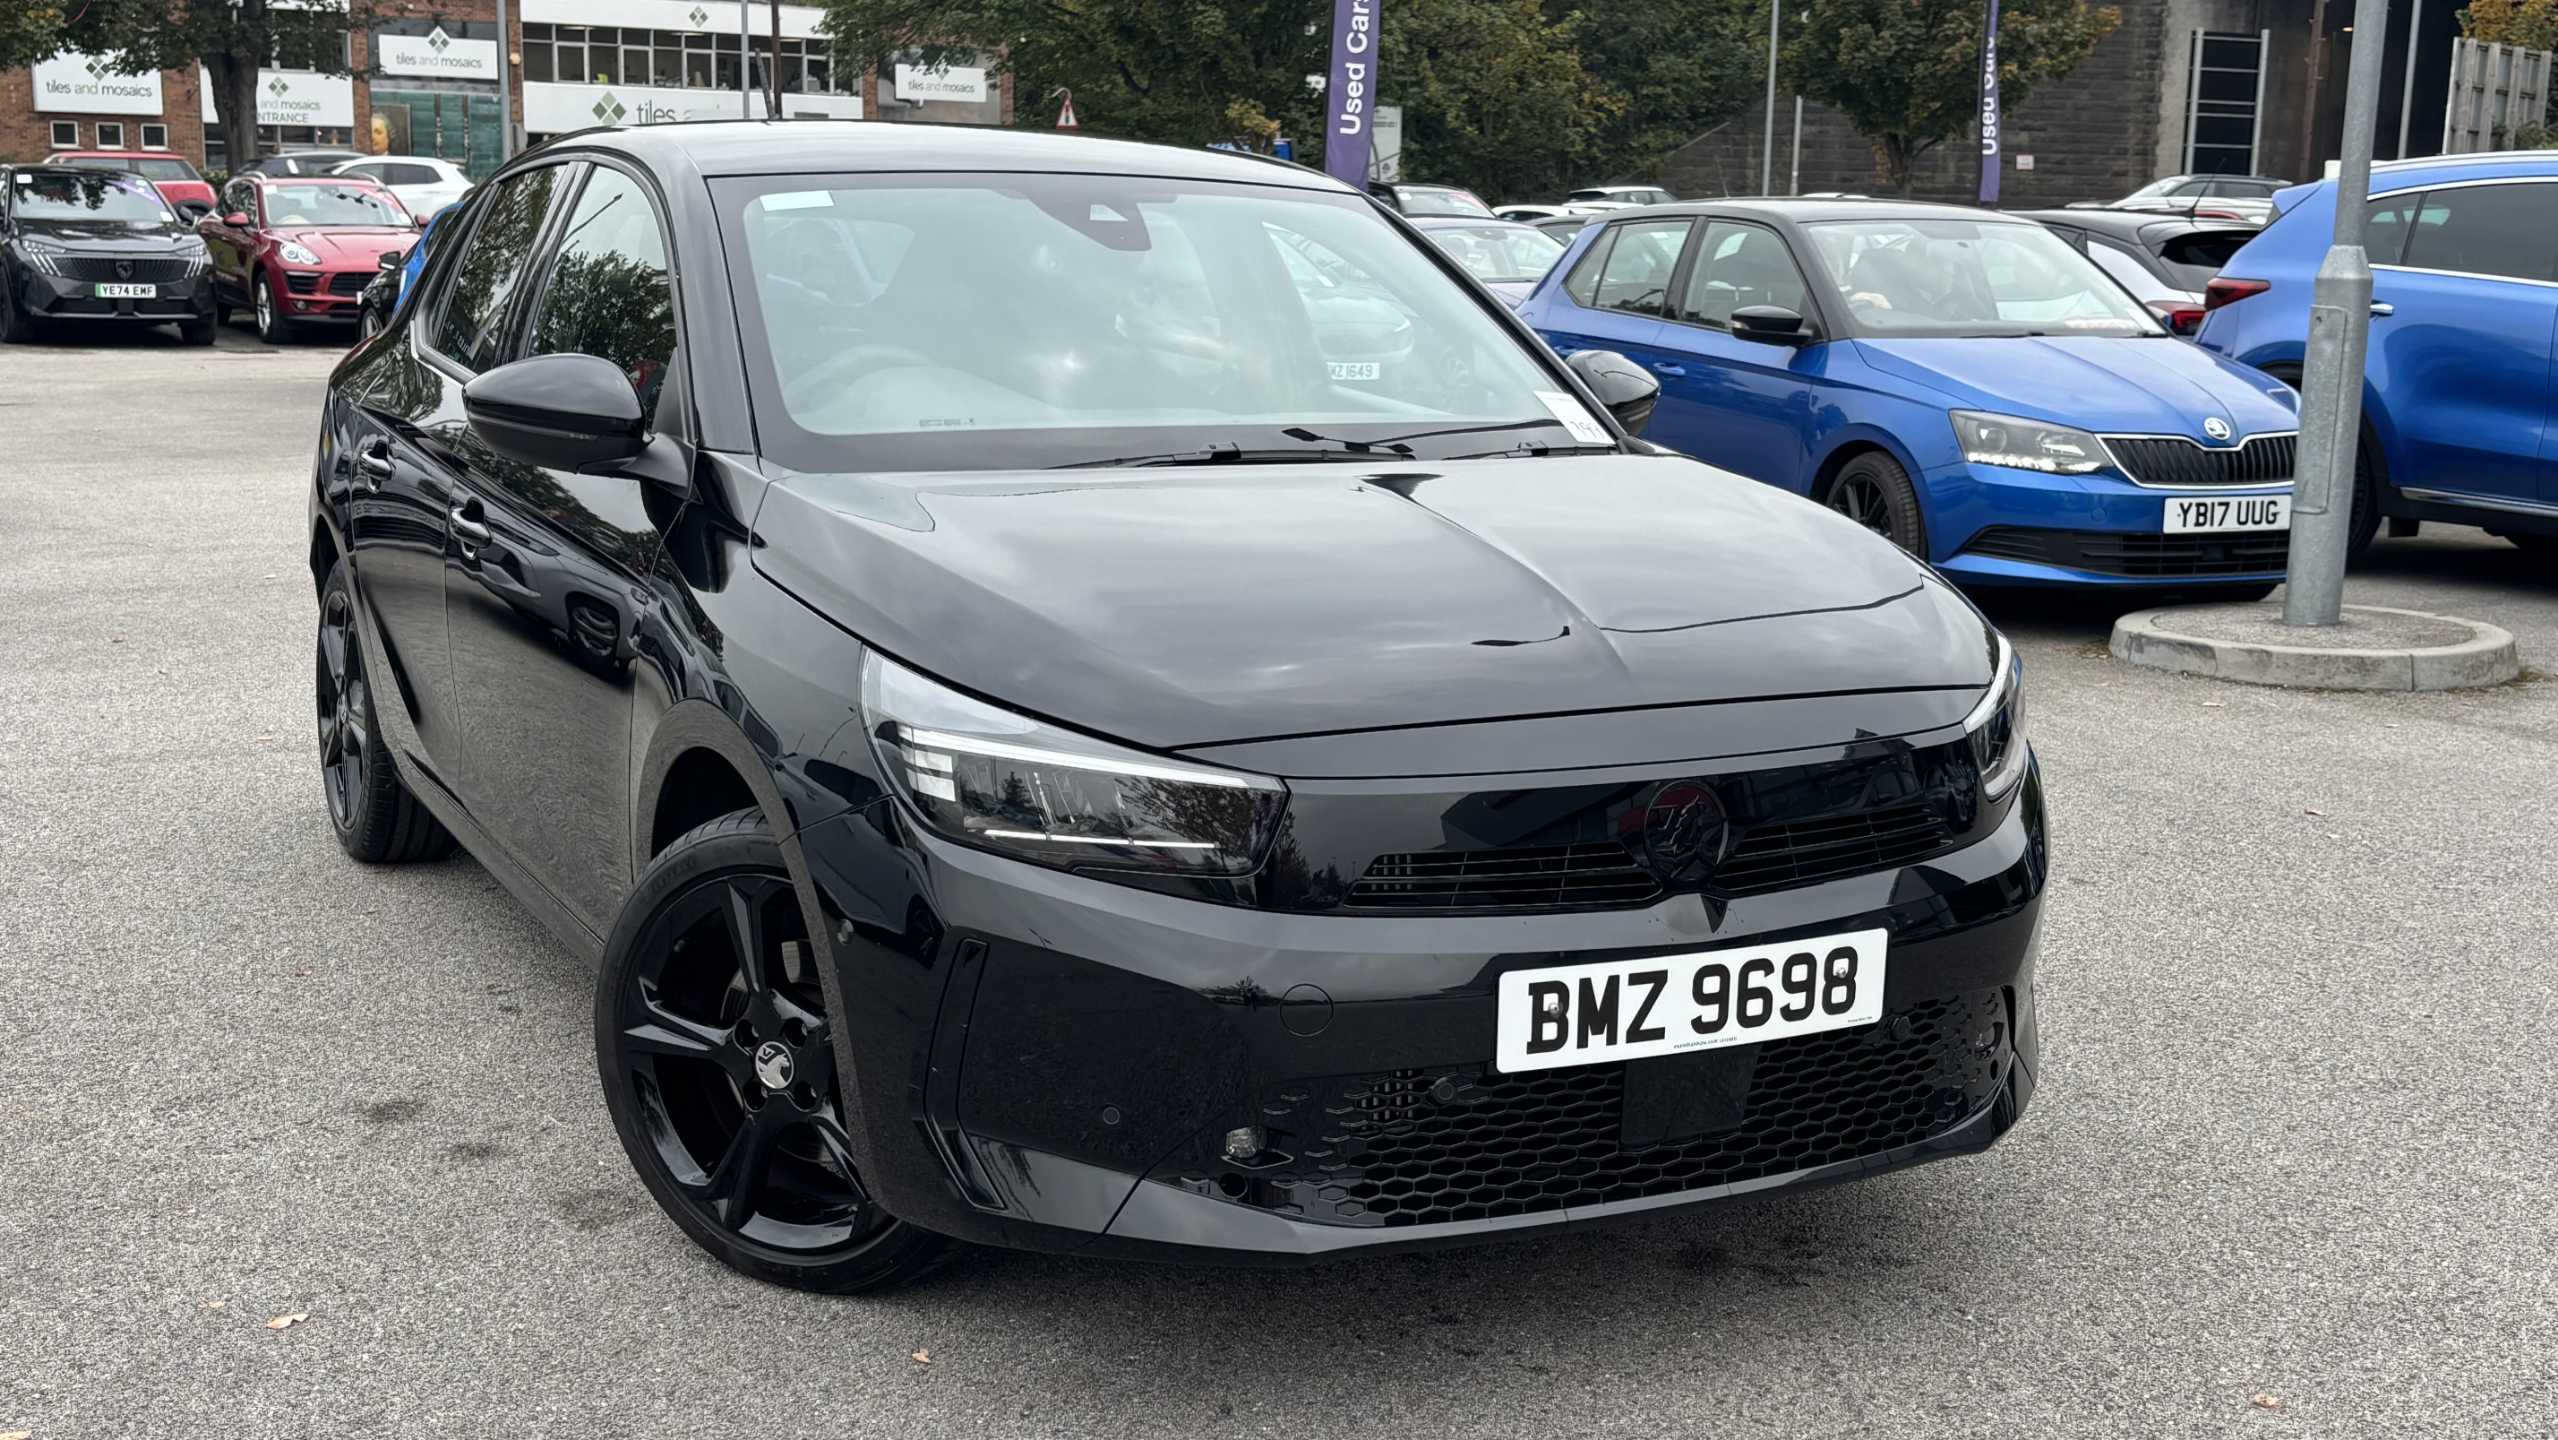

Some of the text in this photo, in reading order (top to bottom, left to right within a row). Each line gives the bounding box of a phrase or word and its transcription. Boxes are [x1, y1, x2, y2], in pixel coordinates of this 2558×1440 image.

[396, 51, 482, 69] tiles and mosaics
[1340, 0, 1370, 134] Used Car
[46, 79, 153, 97] tiles and mosaics
[280, 99, 321, 111] mosaics
[636, 99, 677, 124] tiles
[257, 112, 310, 123] NTRANCE
[102, 285, 130, 297] YE74
[2179, 500, 2279, 528] YB17 UUG
[1526, 946, 1858, 1055] BMZ 9698
